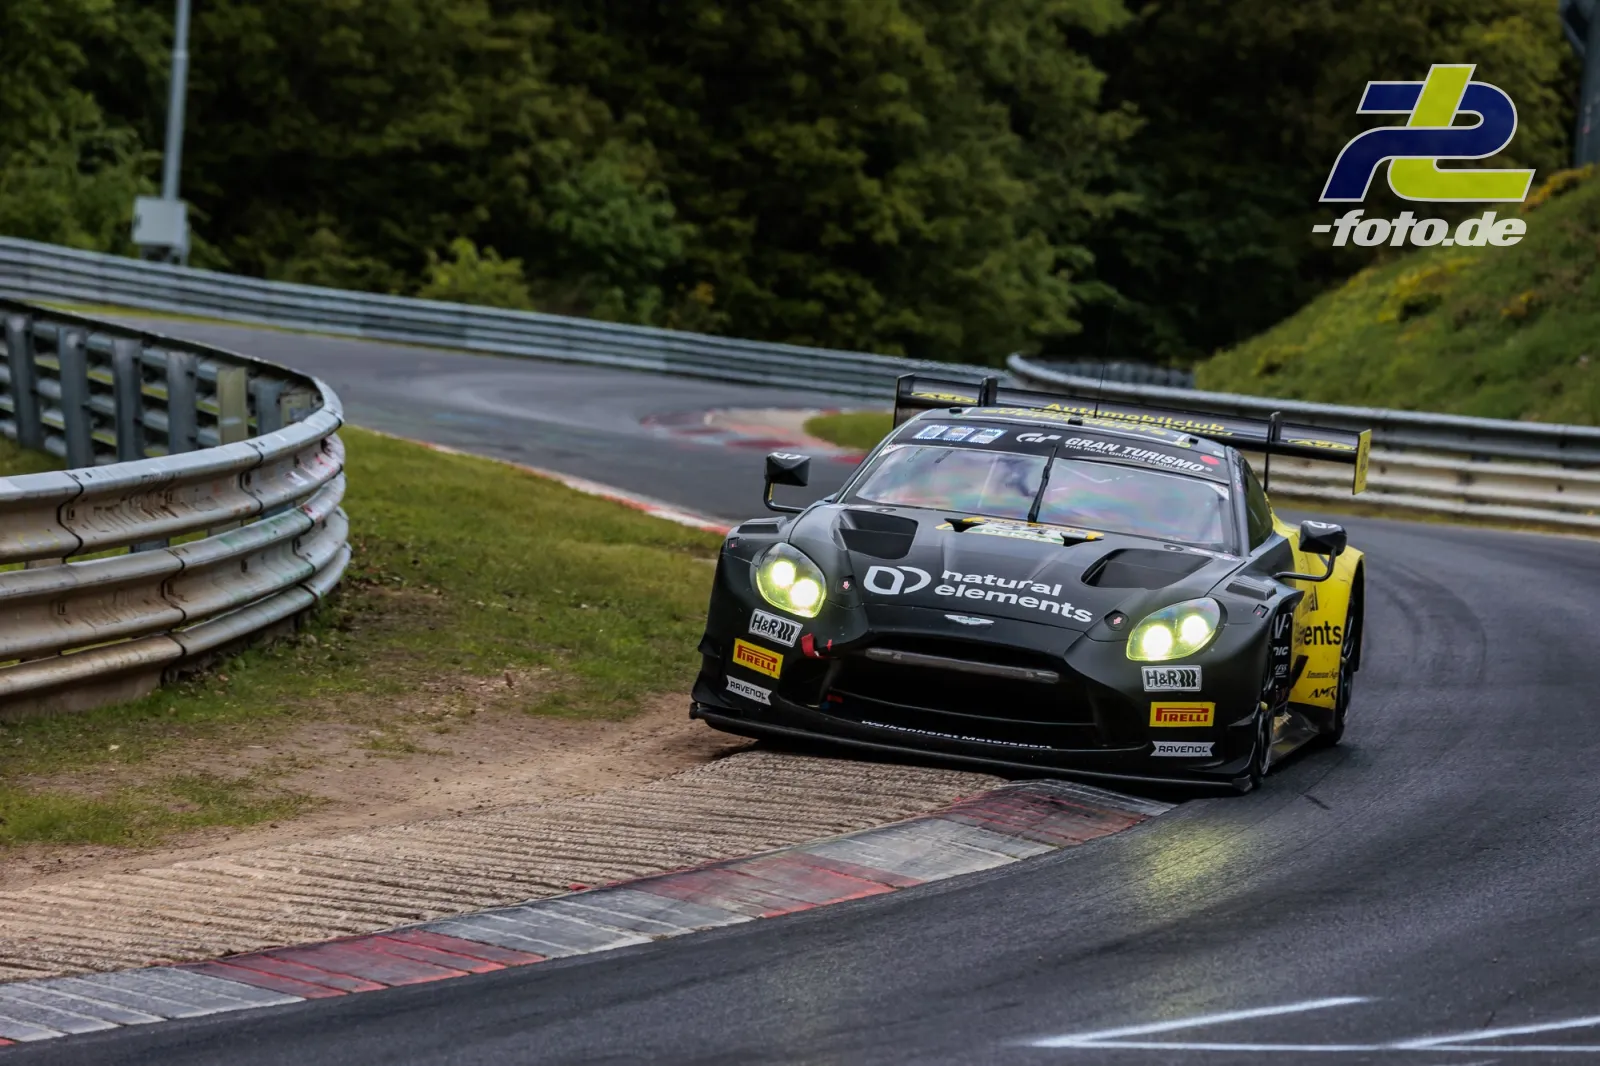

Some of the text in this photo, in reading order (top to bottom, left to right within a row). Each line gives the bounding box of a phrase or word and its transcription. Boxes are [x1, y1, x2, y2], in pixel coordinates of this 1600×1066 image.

[1044, 403, 1225, 431] Automobilclub
[1065, 437, 1205, 472] GRAN TURISMO
[941, 569, 1063, 597] natural
[934, 584, 1094, 623] elements
[751, 613, 781, 636] H&R
[737, 644, 778, 672] PIRELLI
[730, 681, 768, 700] RAVENOL
[1145, 669, 1179, 687] H&R
[1156, 707, 1209, 722] PIRELLI
[1158, 745, 1209, 753] RAVENOL
